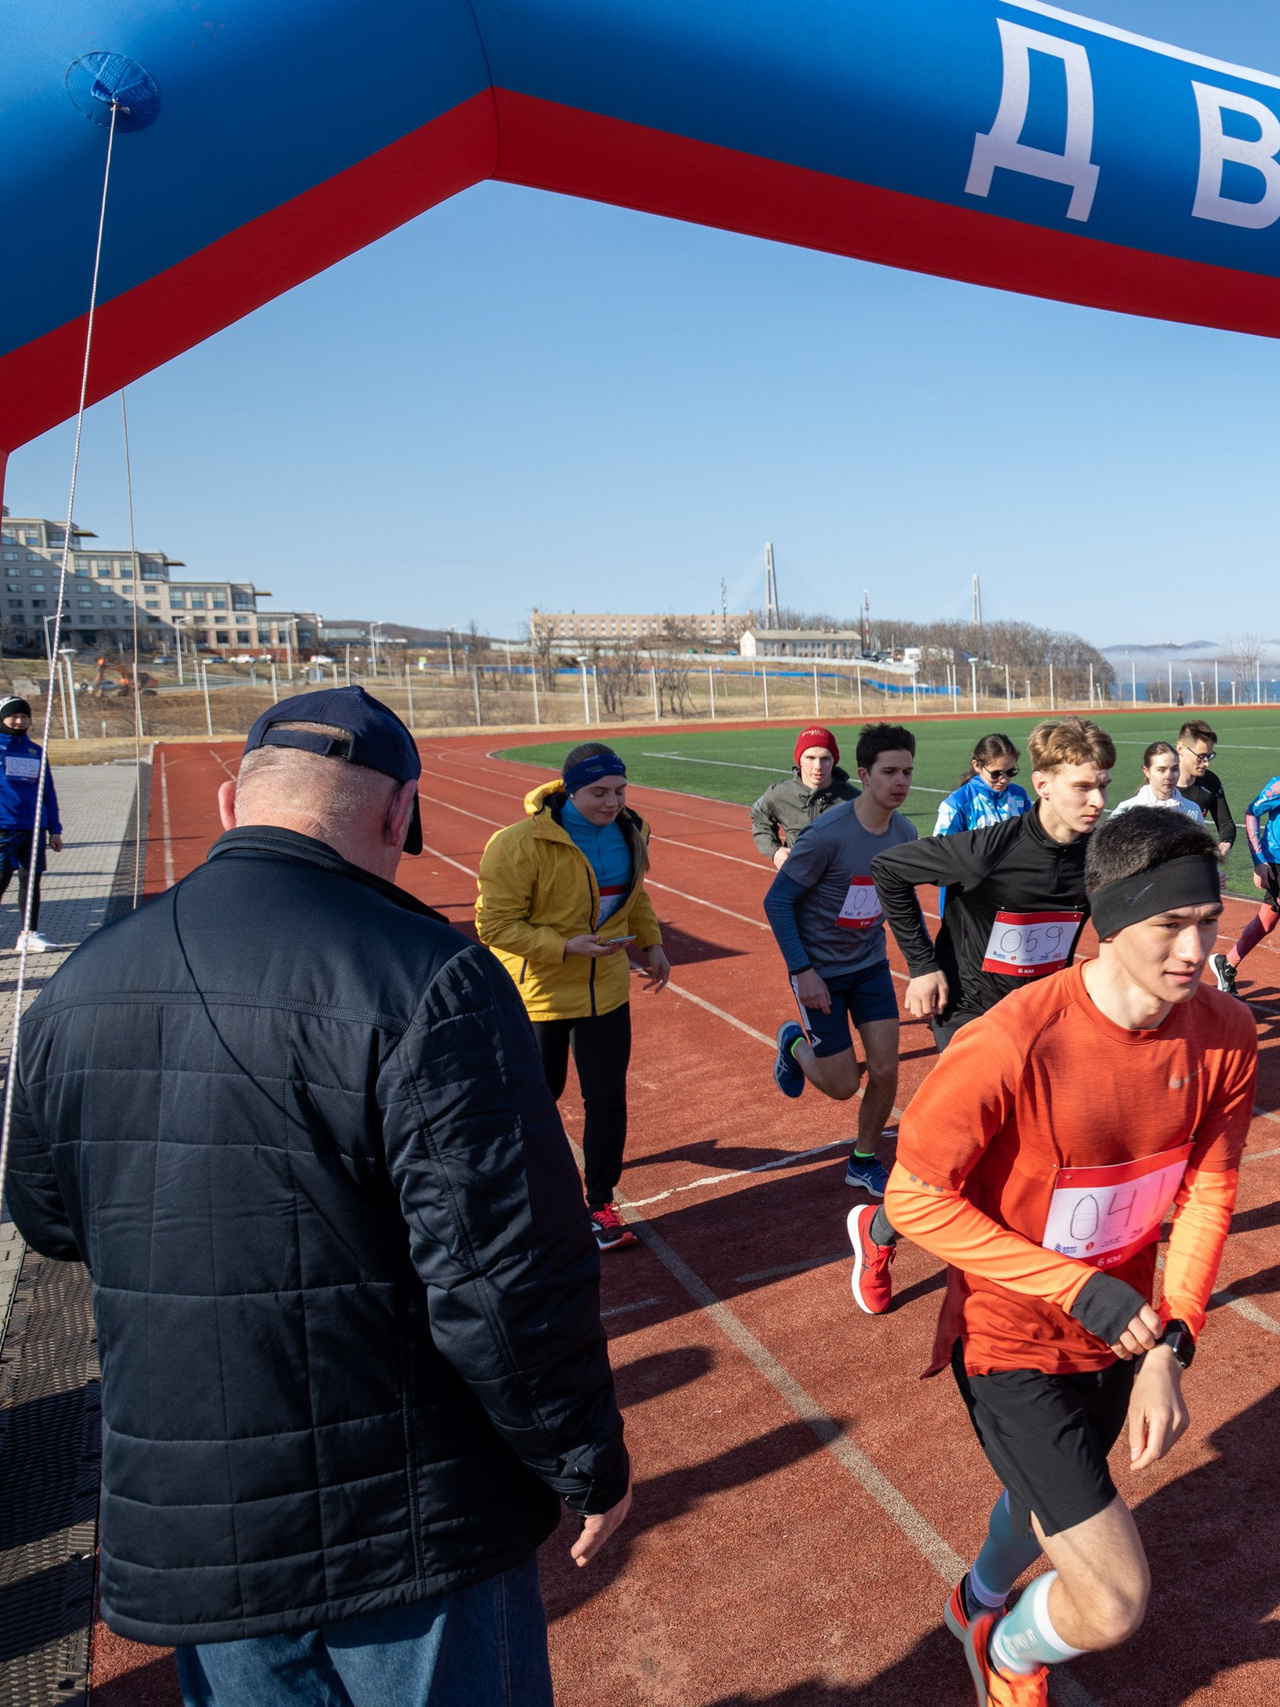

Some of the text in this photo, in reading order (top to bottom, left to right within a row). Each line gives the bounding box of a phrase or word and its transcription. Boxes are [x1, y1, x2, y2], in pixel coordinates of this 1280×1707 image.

[1000, 925, 1064, 954] 059
[1070, 1173, 1166, 1241] 041
[1097, 1257, 1105, 1267] 6
